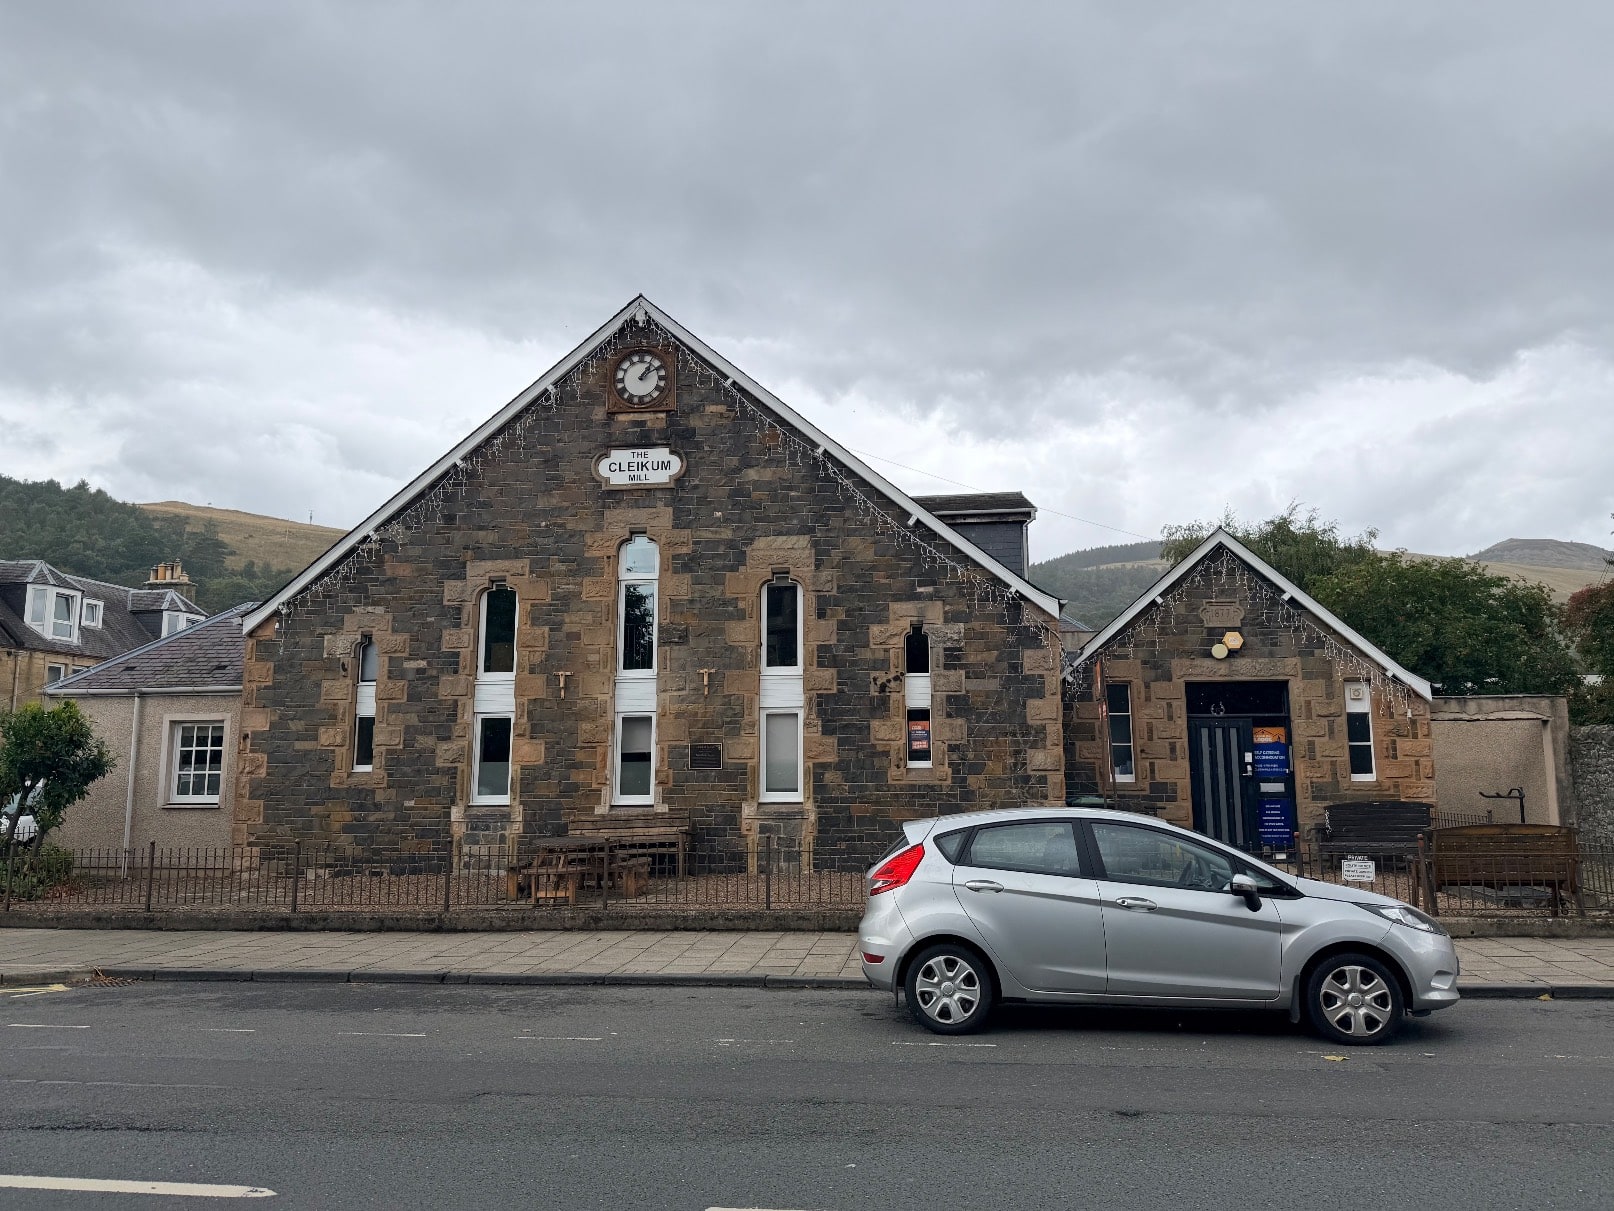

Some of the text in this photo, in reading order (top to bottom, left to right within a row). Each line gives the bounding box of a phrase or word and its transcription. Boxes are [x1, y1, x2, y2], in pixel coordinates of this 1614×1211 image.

[631, 451, 649, 459] THE
[608, 460, 671, 473] CLEIKUM
[628, 474, 650, 482] MILL
